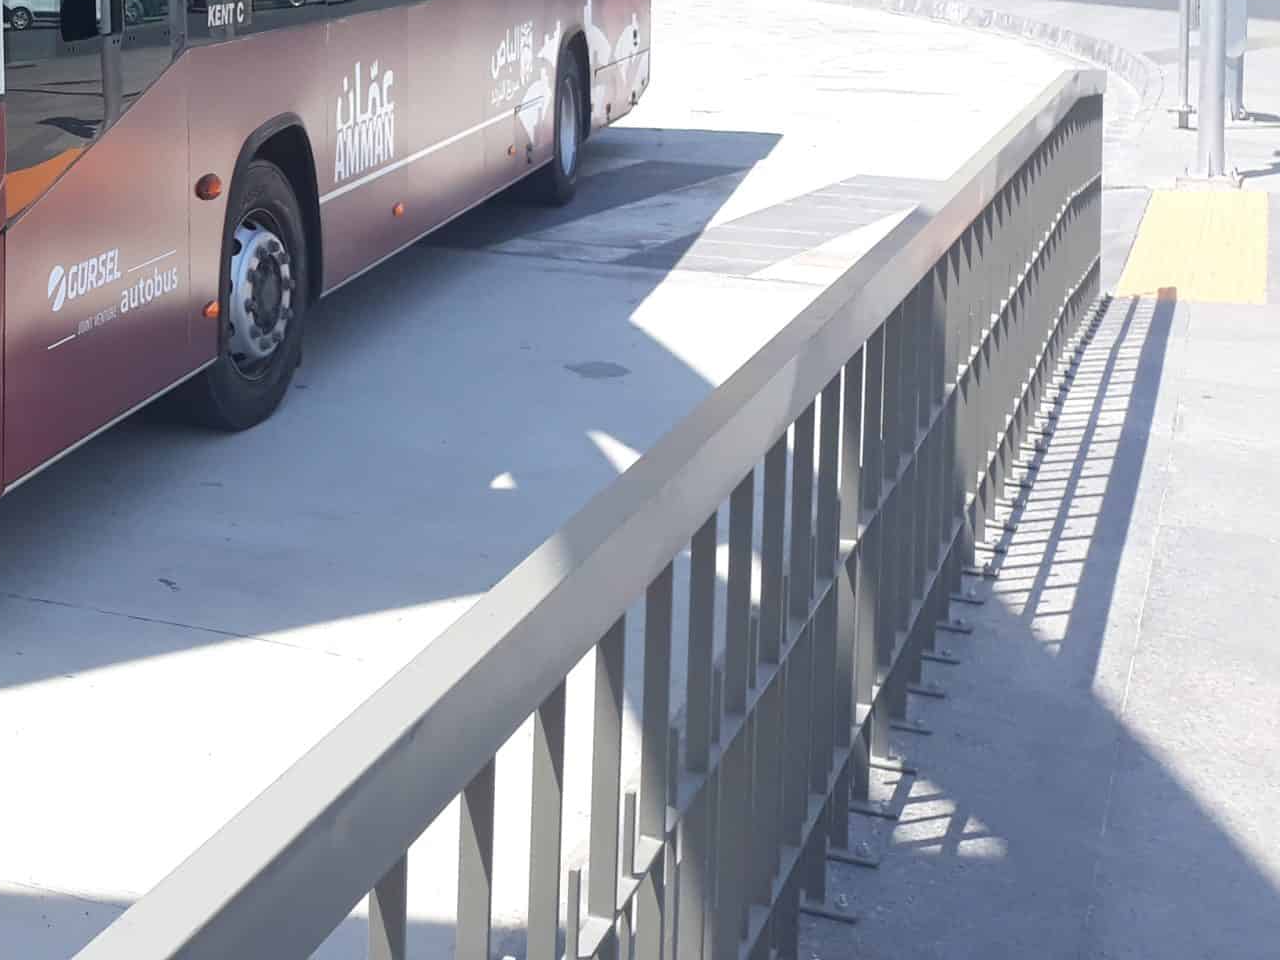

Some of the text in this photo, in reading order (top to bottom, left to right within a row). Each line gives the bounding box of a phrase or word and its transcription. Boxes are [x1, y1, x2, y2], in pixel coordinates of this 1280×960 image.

[207, 1, 244, 27] KENT C
[334, 111, 394, 182] AMMAN
[121, 266, 178, 313] autobus
